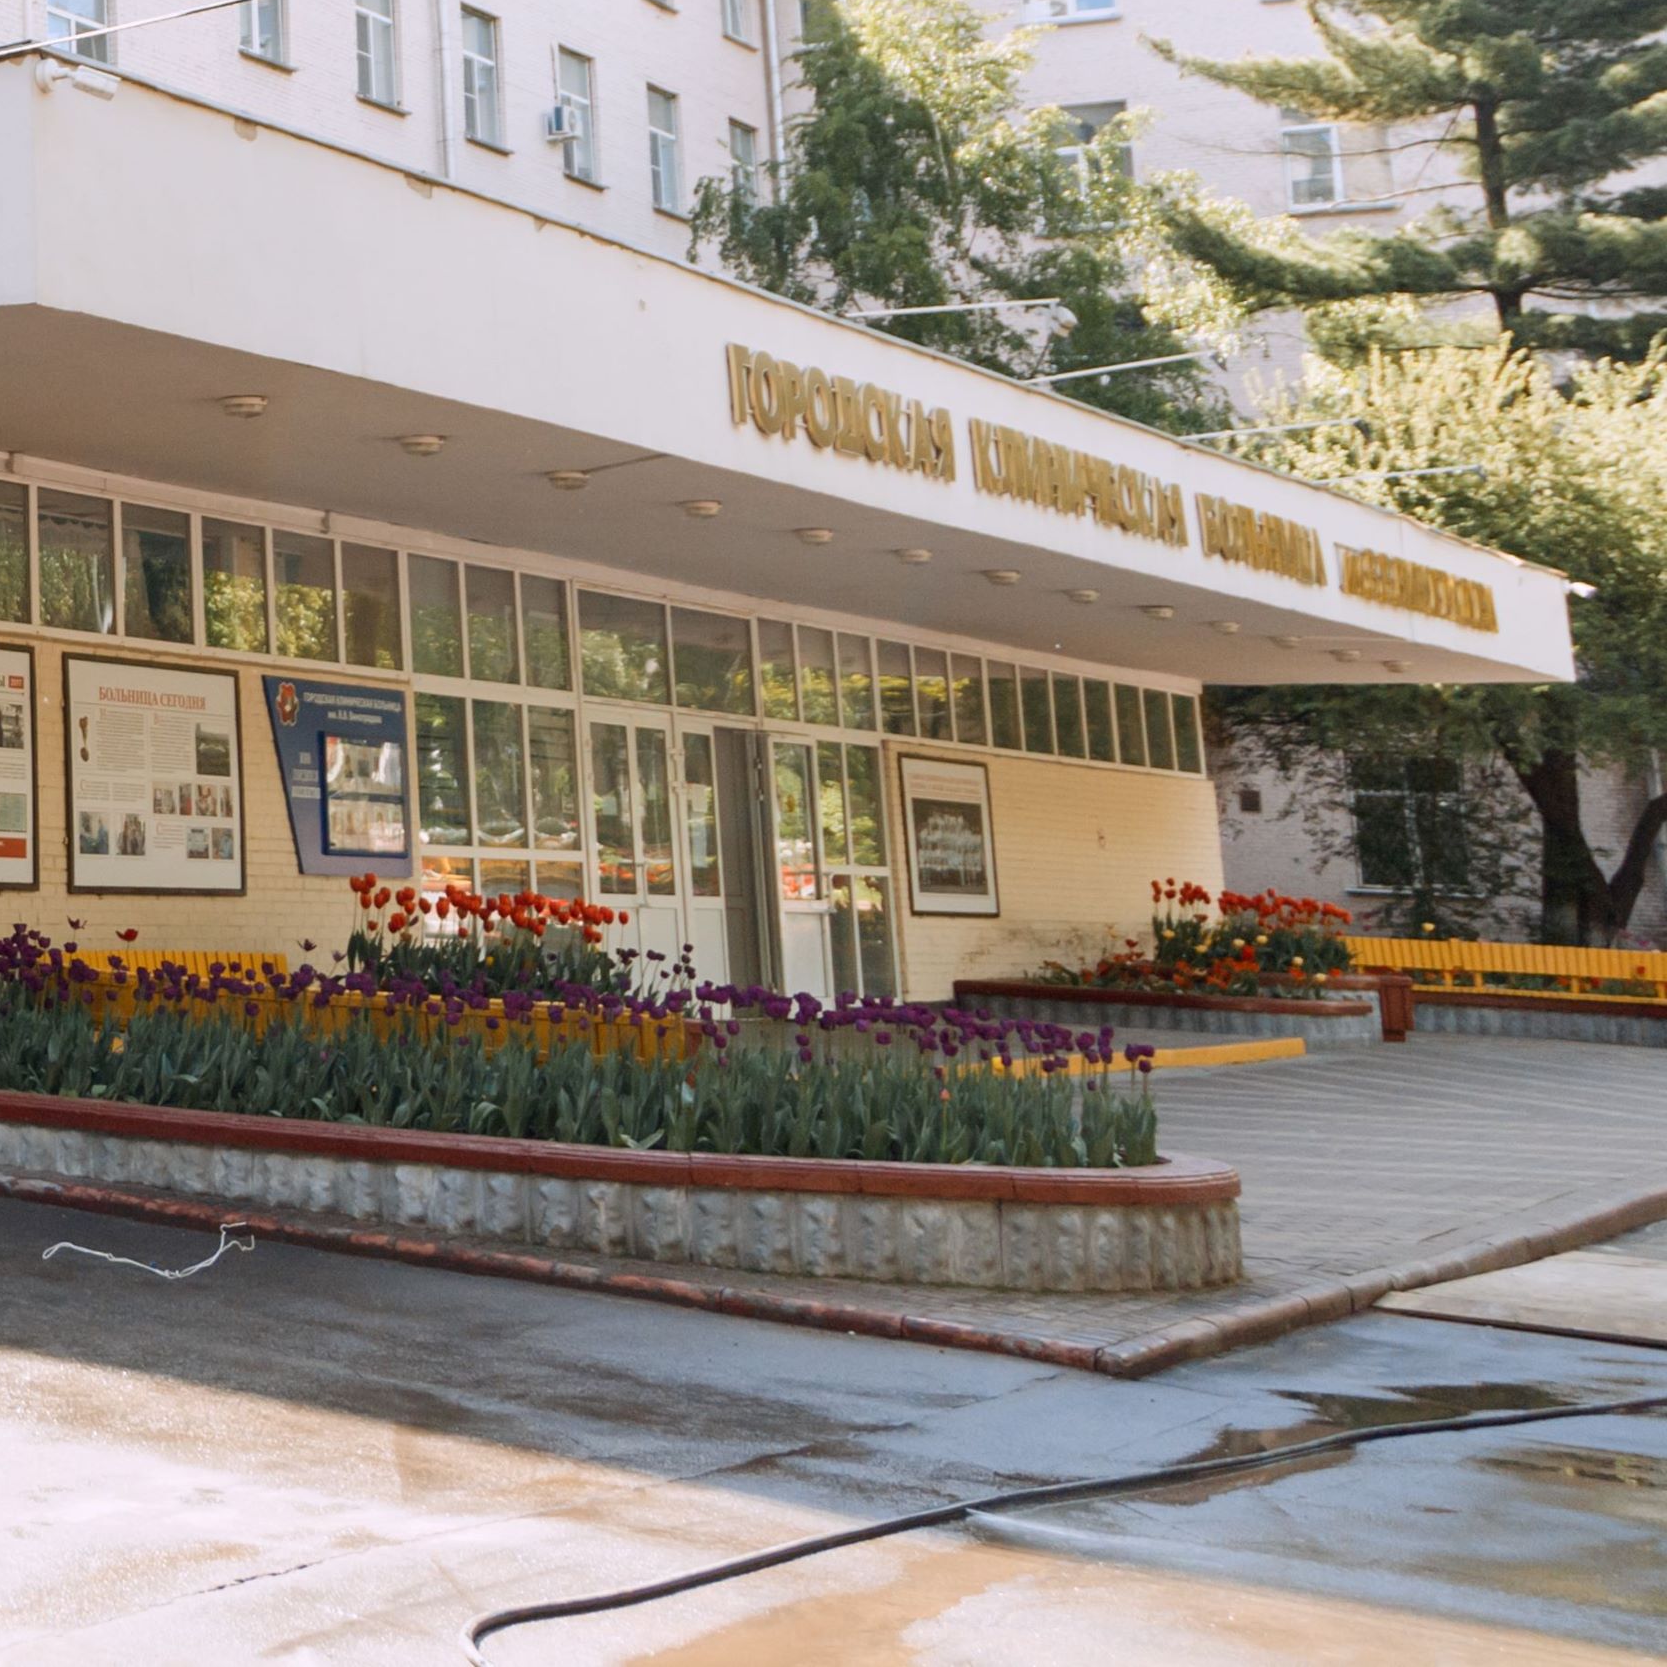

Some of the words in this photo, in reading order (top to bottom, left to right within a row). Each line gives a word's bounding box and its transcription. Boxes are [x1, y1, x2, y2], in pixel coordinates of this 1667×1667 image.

[726, 342, 956, 482] ГОРОДСКАЯ
[98, 686, 158, 706] БОЛЬНИЦА
[159, 692, 206, 711] СЕГОДНЯ
